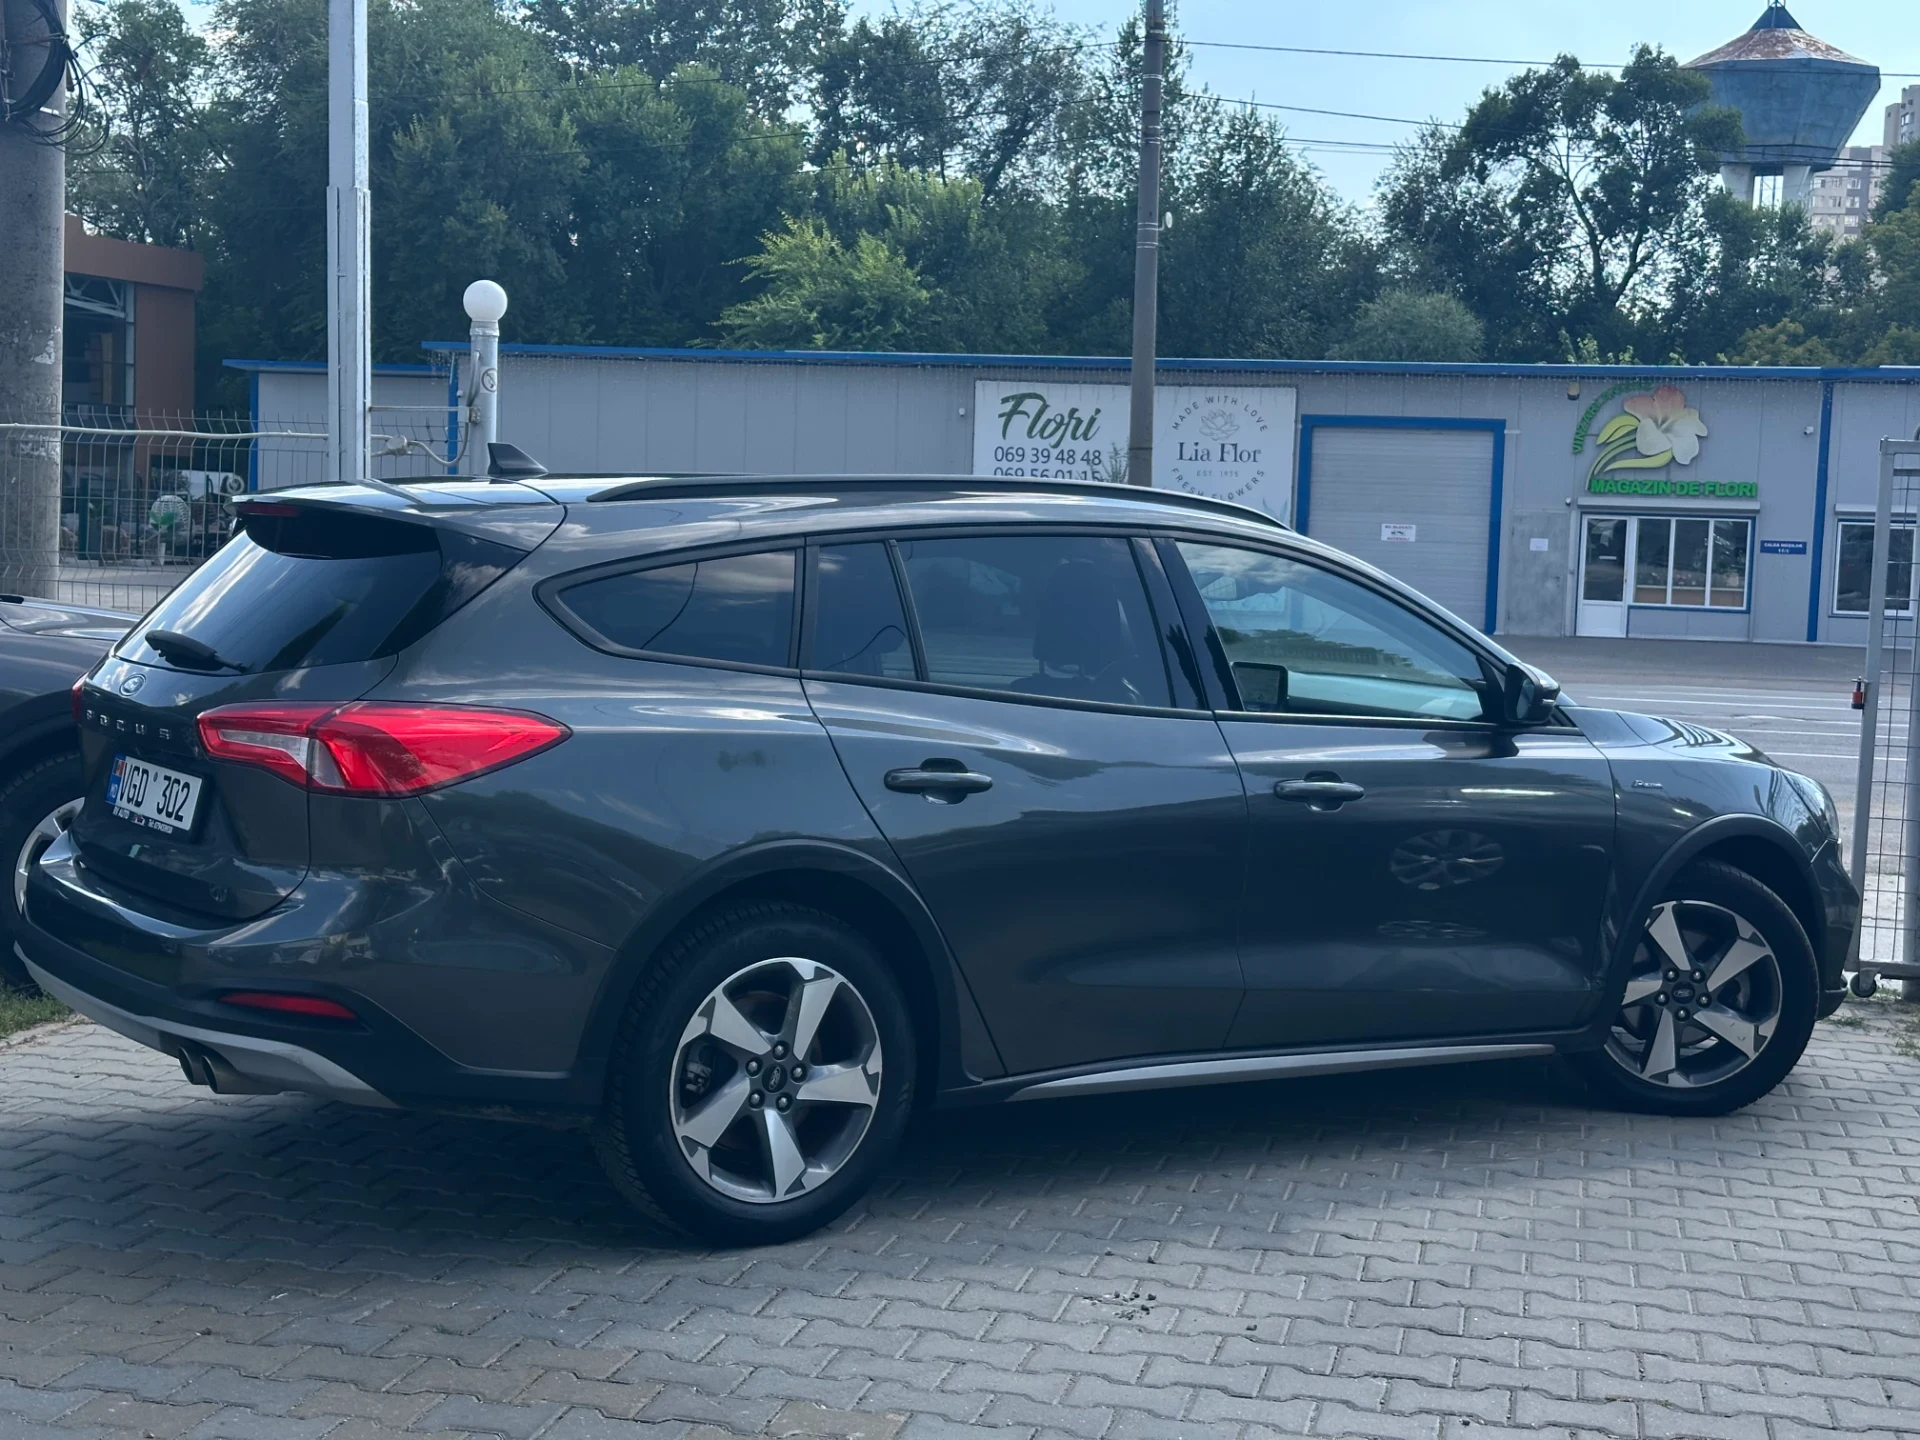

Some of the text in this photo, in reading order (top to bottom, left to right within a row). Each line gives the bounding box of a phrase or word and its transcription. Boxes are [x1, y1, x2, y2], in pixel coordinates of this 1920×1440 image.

[997, 392, 1102, 449] Flori
[1172, 395, 1268, 432] MADE WITH LOVE
[994, 446, 1102, 467] 069 39 48 48
[1176, 441, 1261, 463] Lia Flor
[1171, 468, 1265, 500] FRESH FLOWERS
[1589, 479, 1758, 497] MAGAZIN DE FLORI
[86, 709, 171, 740] FOCUS
[119, 762, 191, 823] VGD 302
